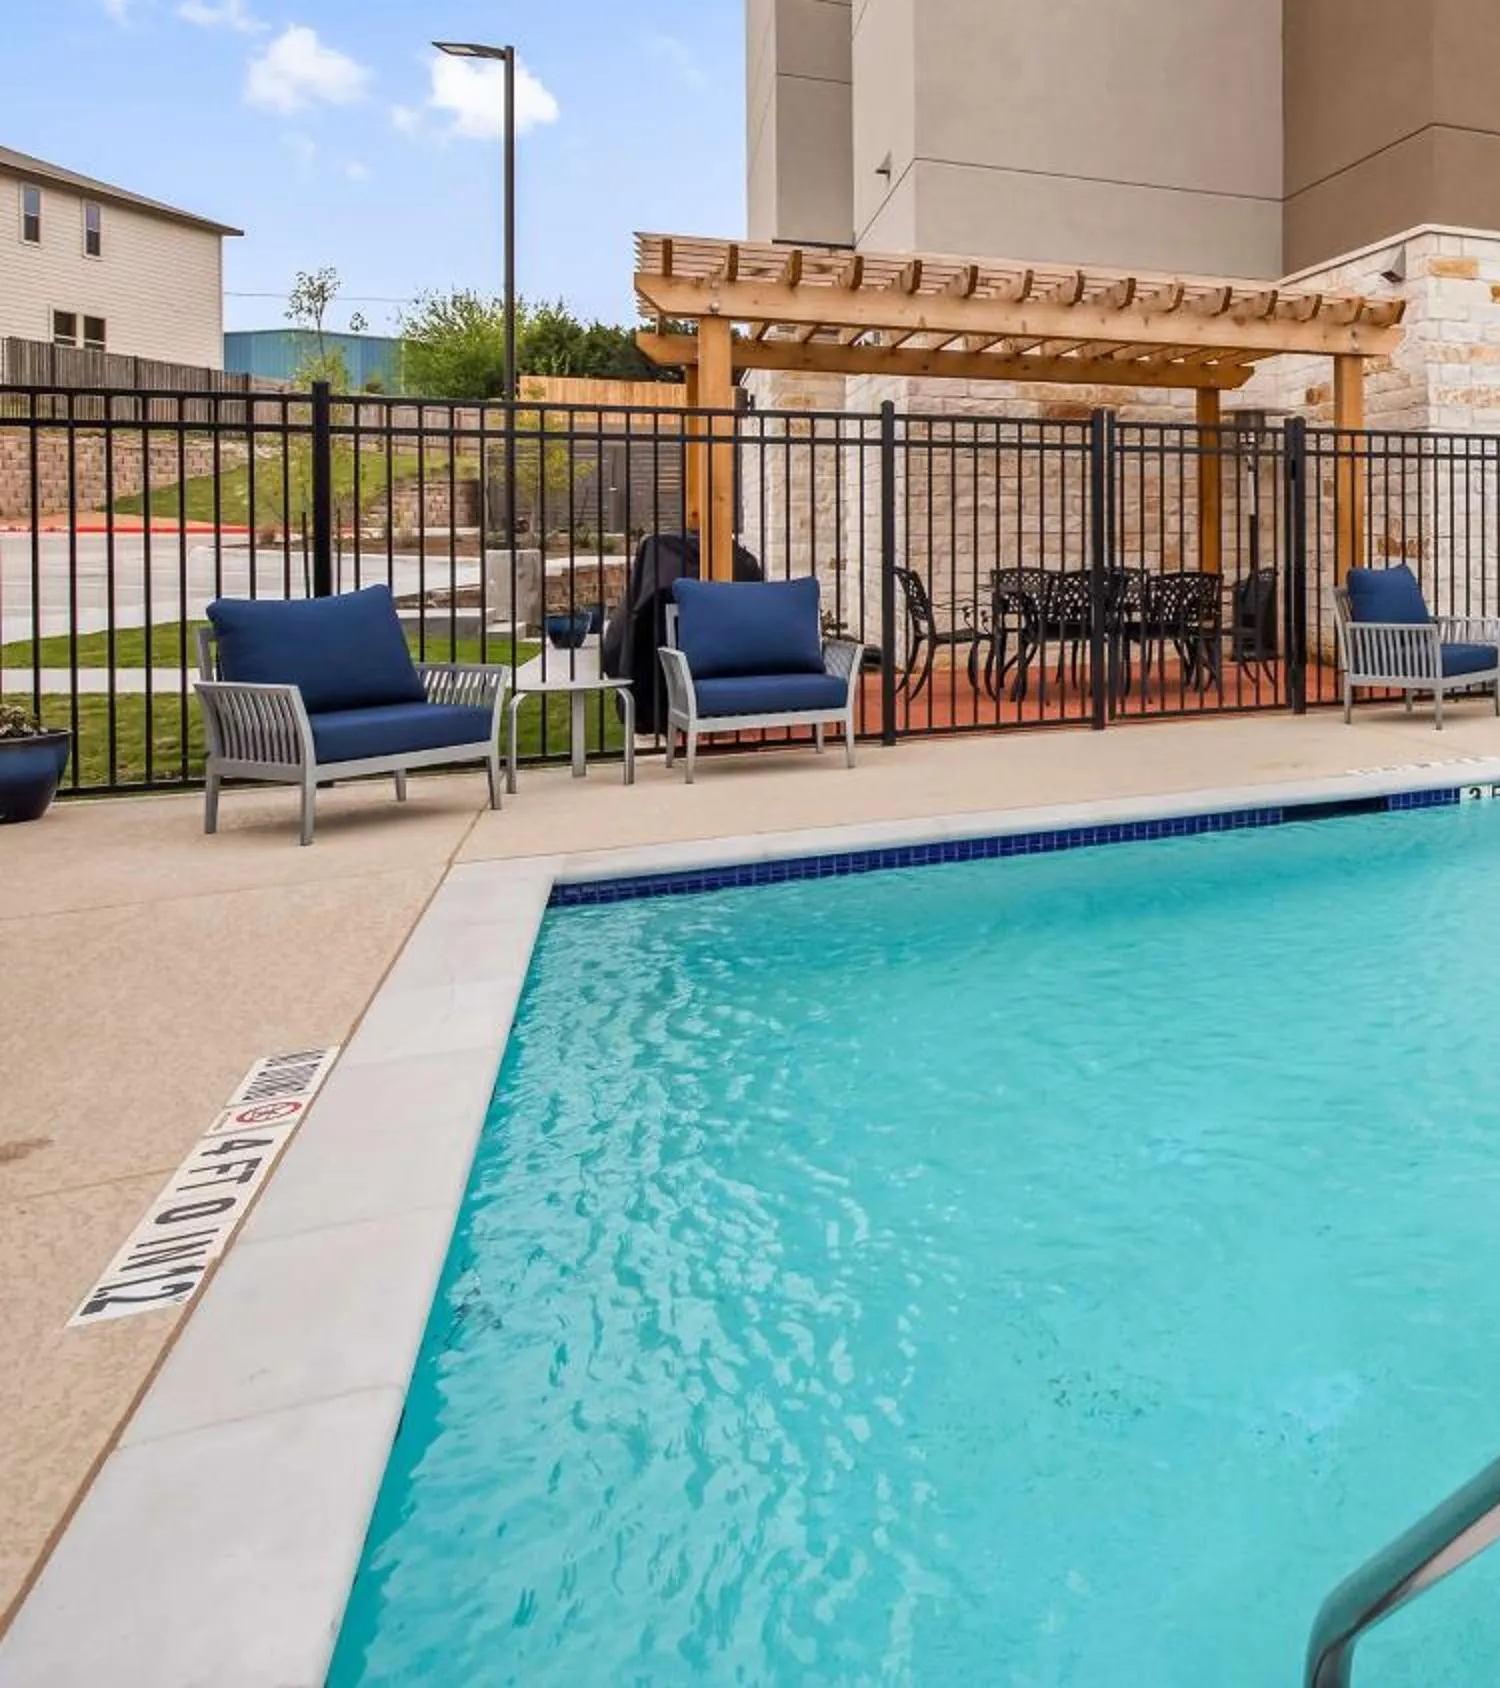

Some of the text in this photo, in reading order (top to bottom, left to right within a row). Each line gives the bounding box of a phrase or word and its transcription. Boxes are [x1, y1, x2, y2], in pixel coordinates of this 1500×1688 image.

[201, 1138, 274, 1156] 4
[175, 1157, 263, 1192] FT
[119, 1228, 220, 1274] IN
